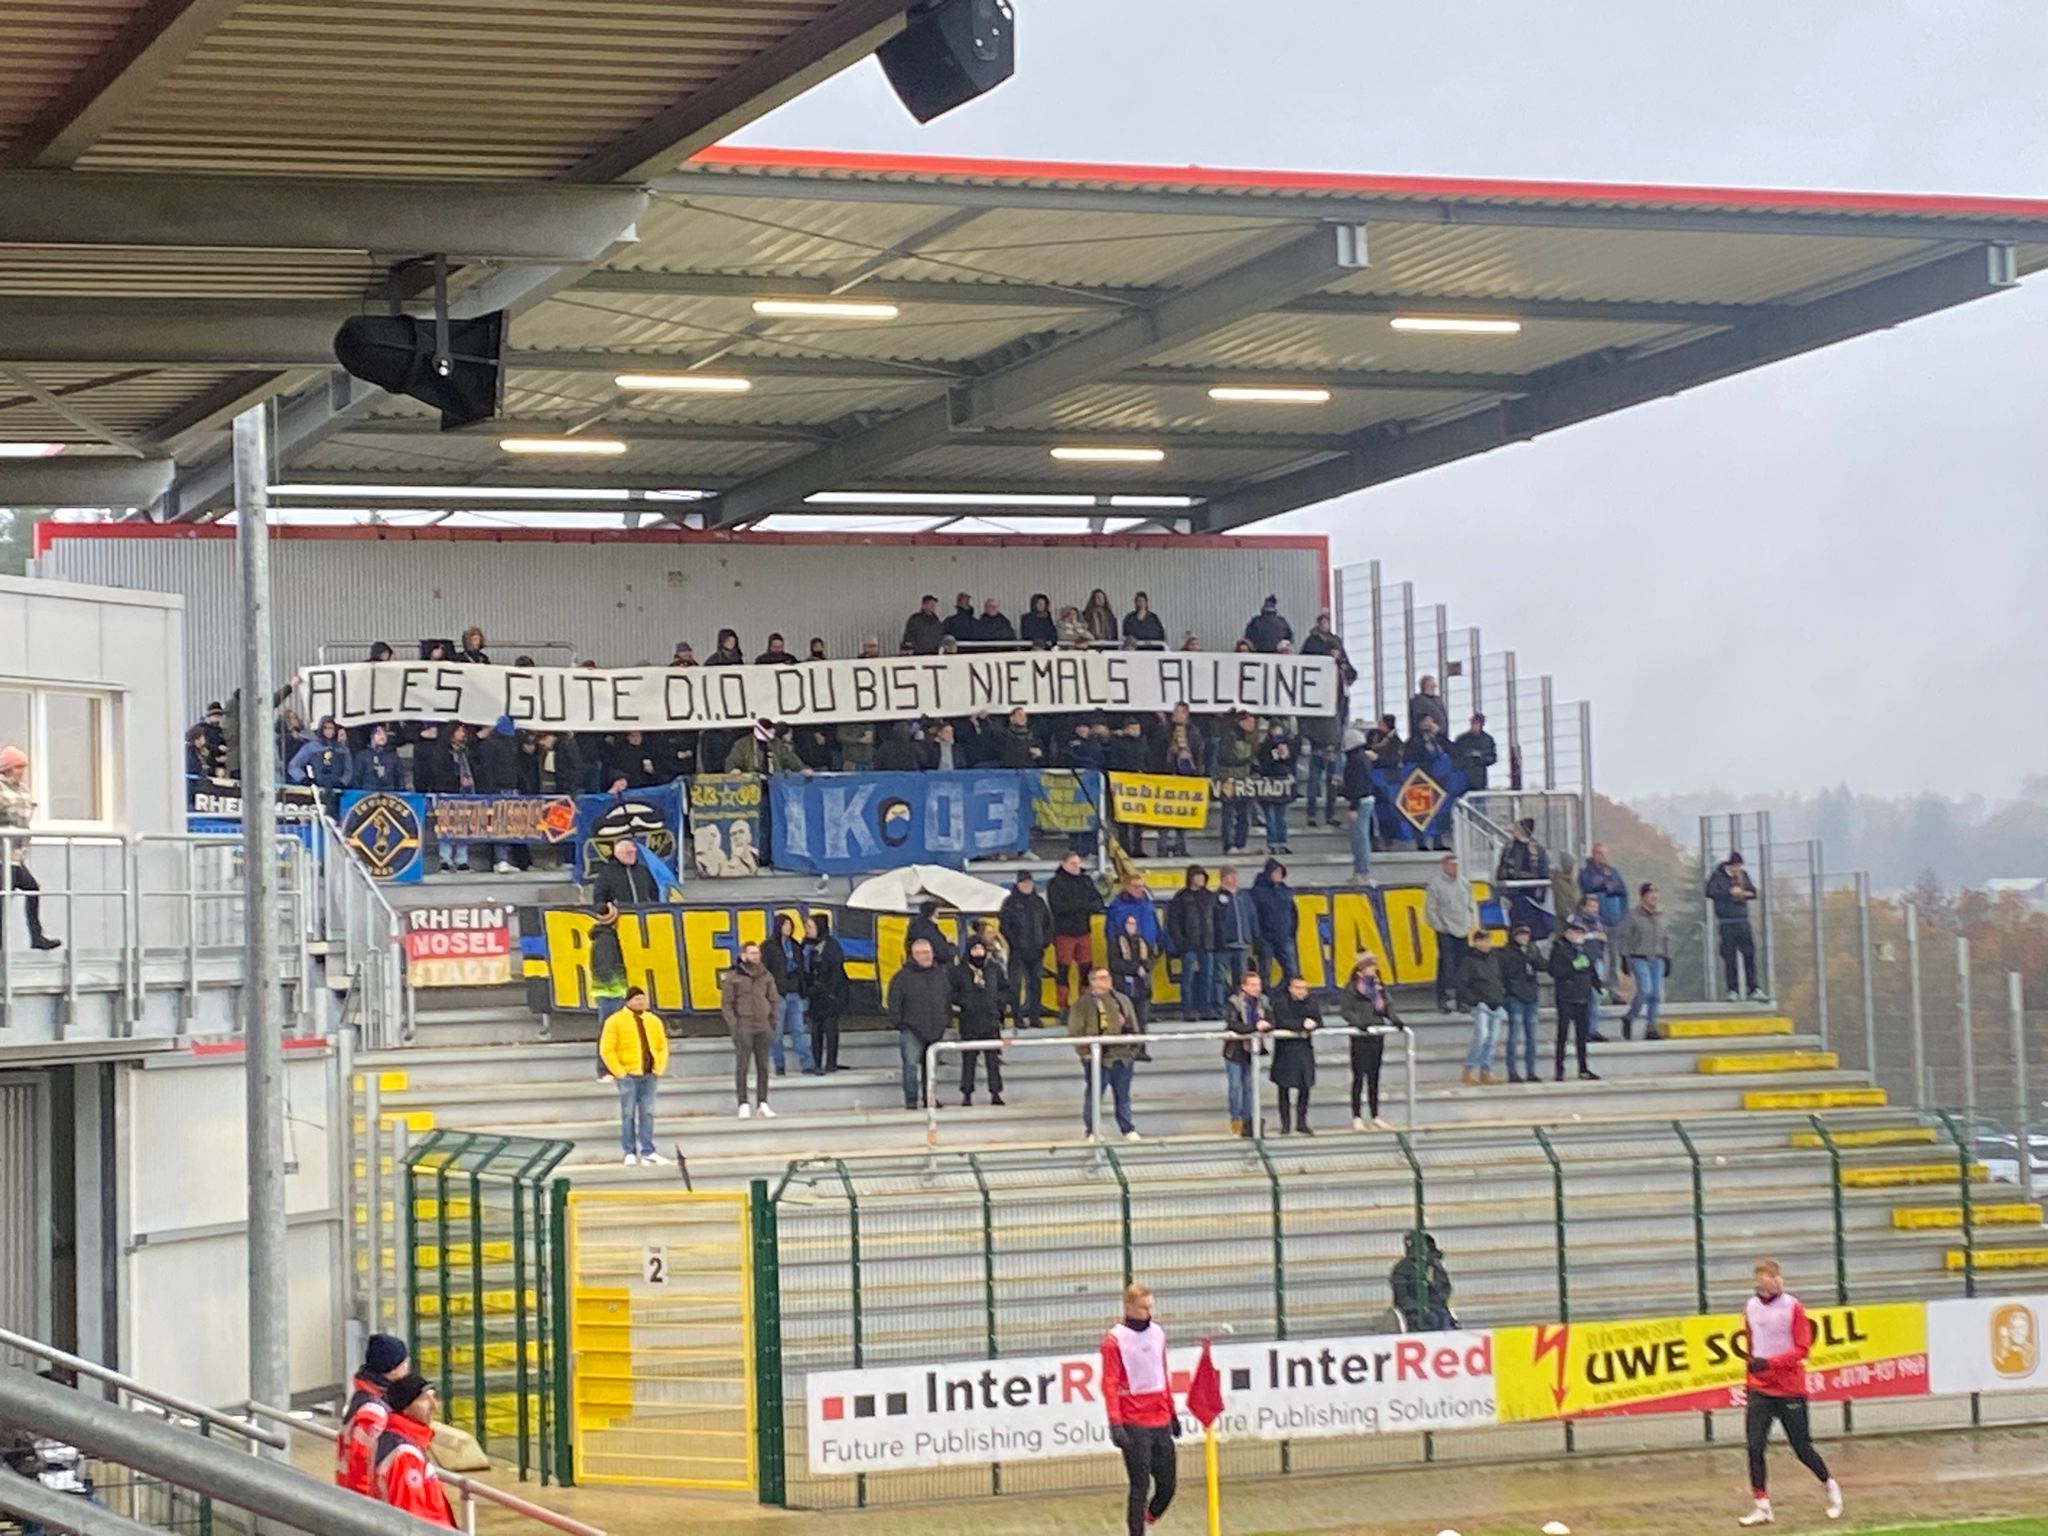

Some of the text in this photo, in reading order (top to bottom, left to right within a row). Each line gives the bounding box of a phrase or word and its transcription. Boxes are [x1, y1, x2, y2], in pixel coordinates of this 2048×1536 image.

[308, 667, 464, 723] ALLES
[504, 672, 644, 722] GUTE
[775, 667, 837, 715] DU
[853, 664, 948, 712] BIST
[968, 658, 1132, 706] NIEMALS
[1158, 658, 1323, 708] ALLEINE
[1208, 774, 1295, 798] VRSTADT
[924, 778, 1021, 852] 03
[1121, 801, 1199, 817] on tour
[410, 908, 504, 930] RHEIN
[649, 1257, 664, 1283] 2
[1268, 1334, 1493, 1389] InterRed
[1585, 1338, 1690, 1385] UWE
[926, 1361, 1098, 1413] InterR
[1257, 1399, 1379, 1430] Publishing
[1388, 1396, 1496, 1422] Solutions
[821, 1437, 905, 1463] Future
[915, 1427, 1043, 1459] Publishing
